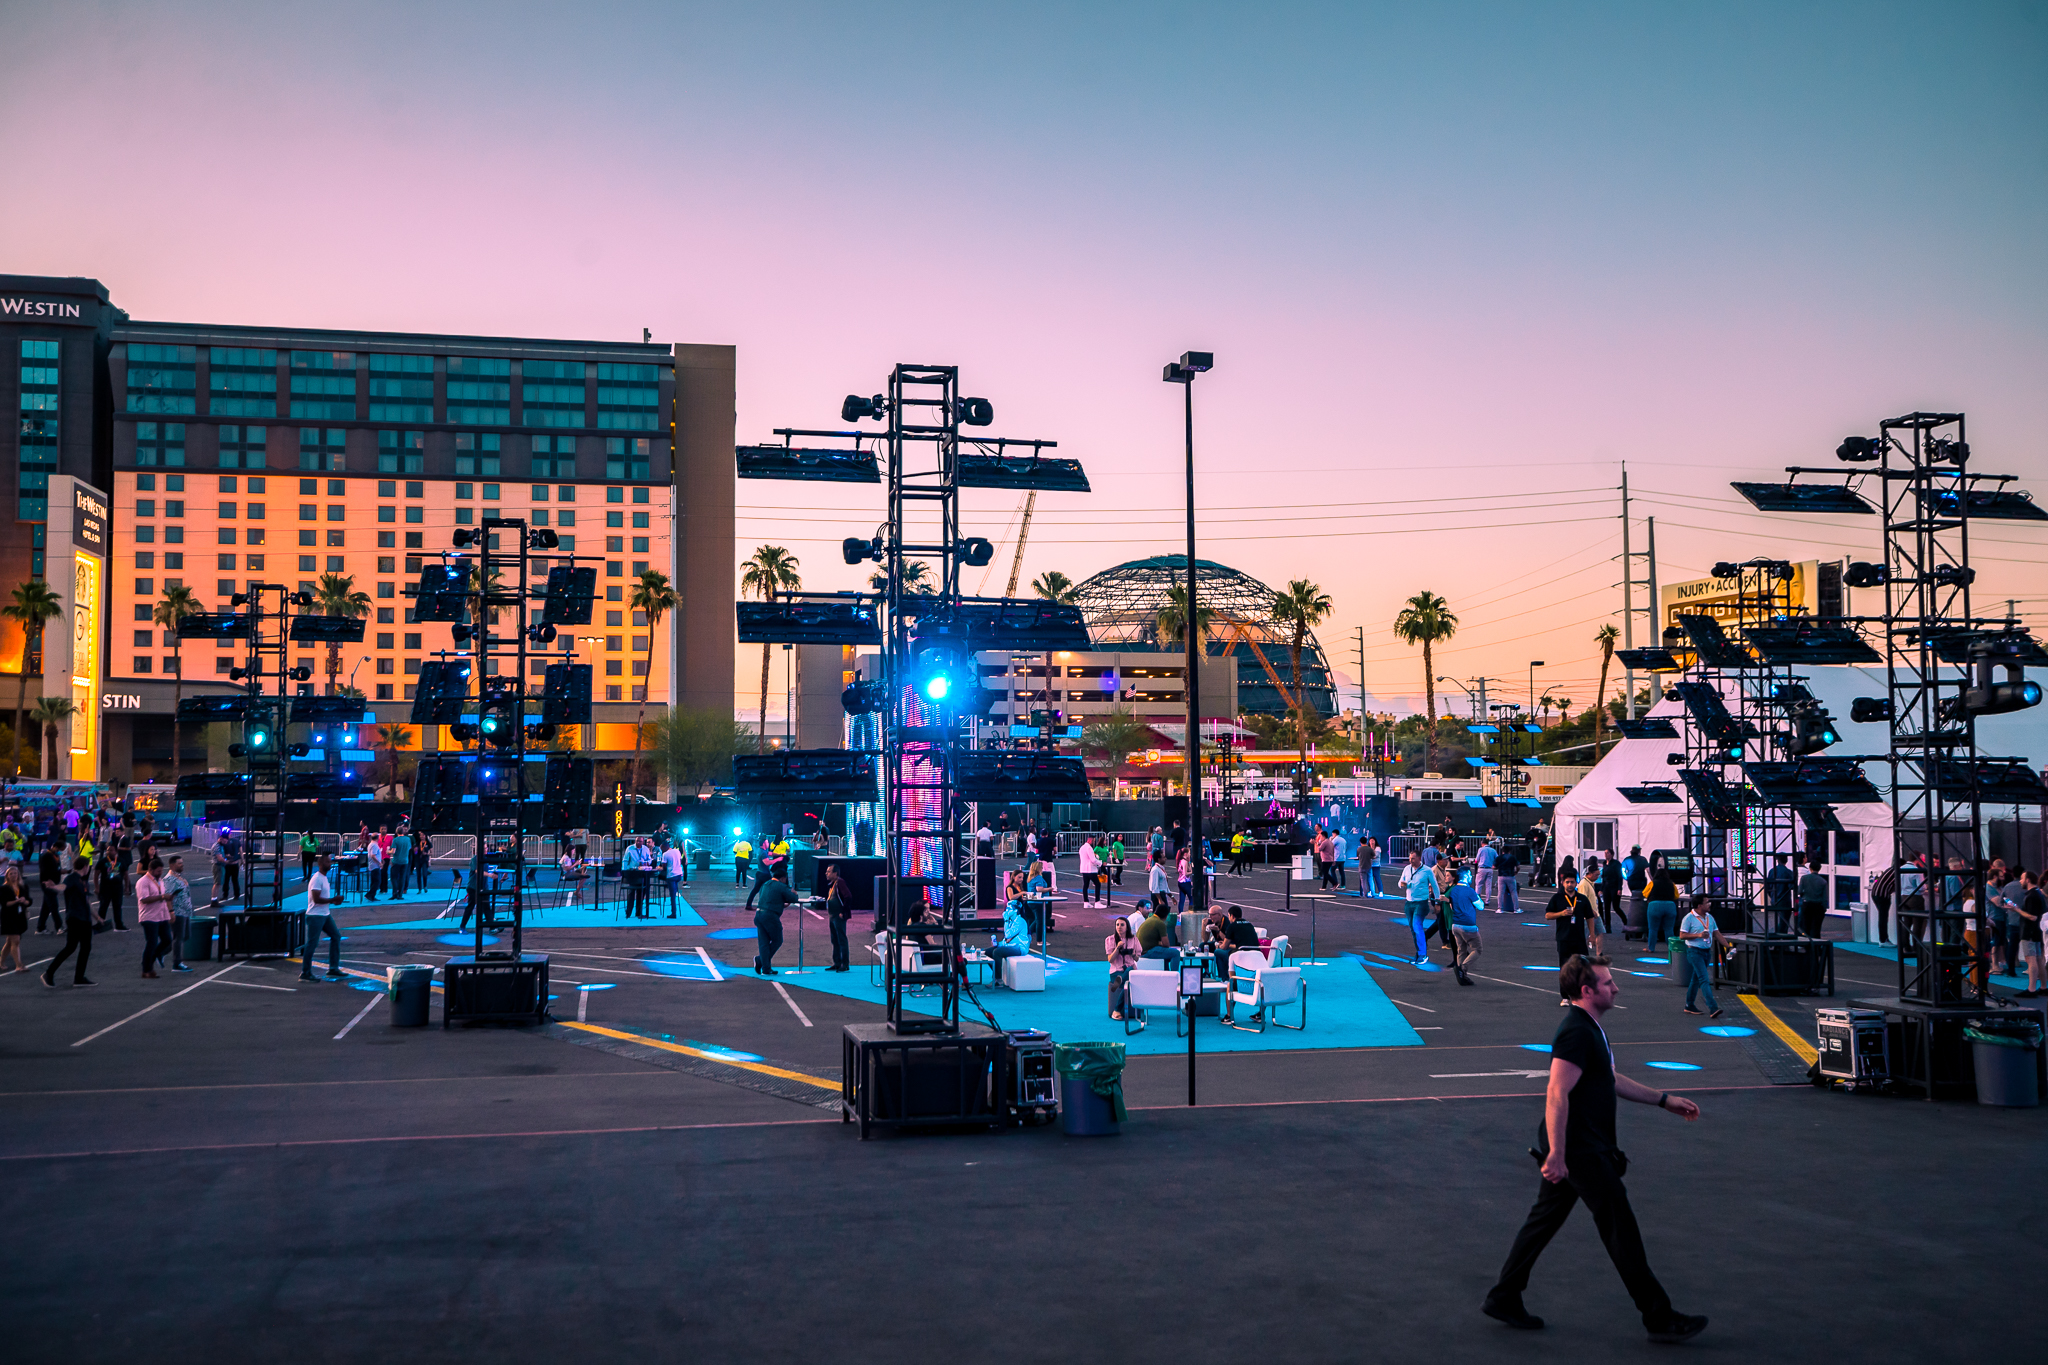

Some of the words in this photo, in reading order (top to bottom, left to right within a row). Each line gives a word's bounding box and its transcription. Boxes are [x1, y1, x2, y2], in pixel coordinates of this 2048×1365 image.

[1, 298, 80, 318] WESTIN
[87, 495, 107, 521] WESTIN
[1677, 582, 1710, 599] INJURY
[1716, 574, 1759, 592] ACCIDEN
